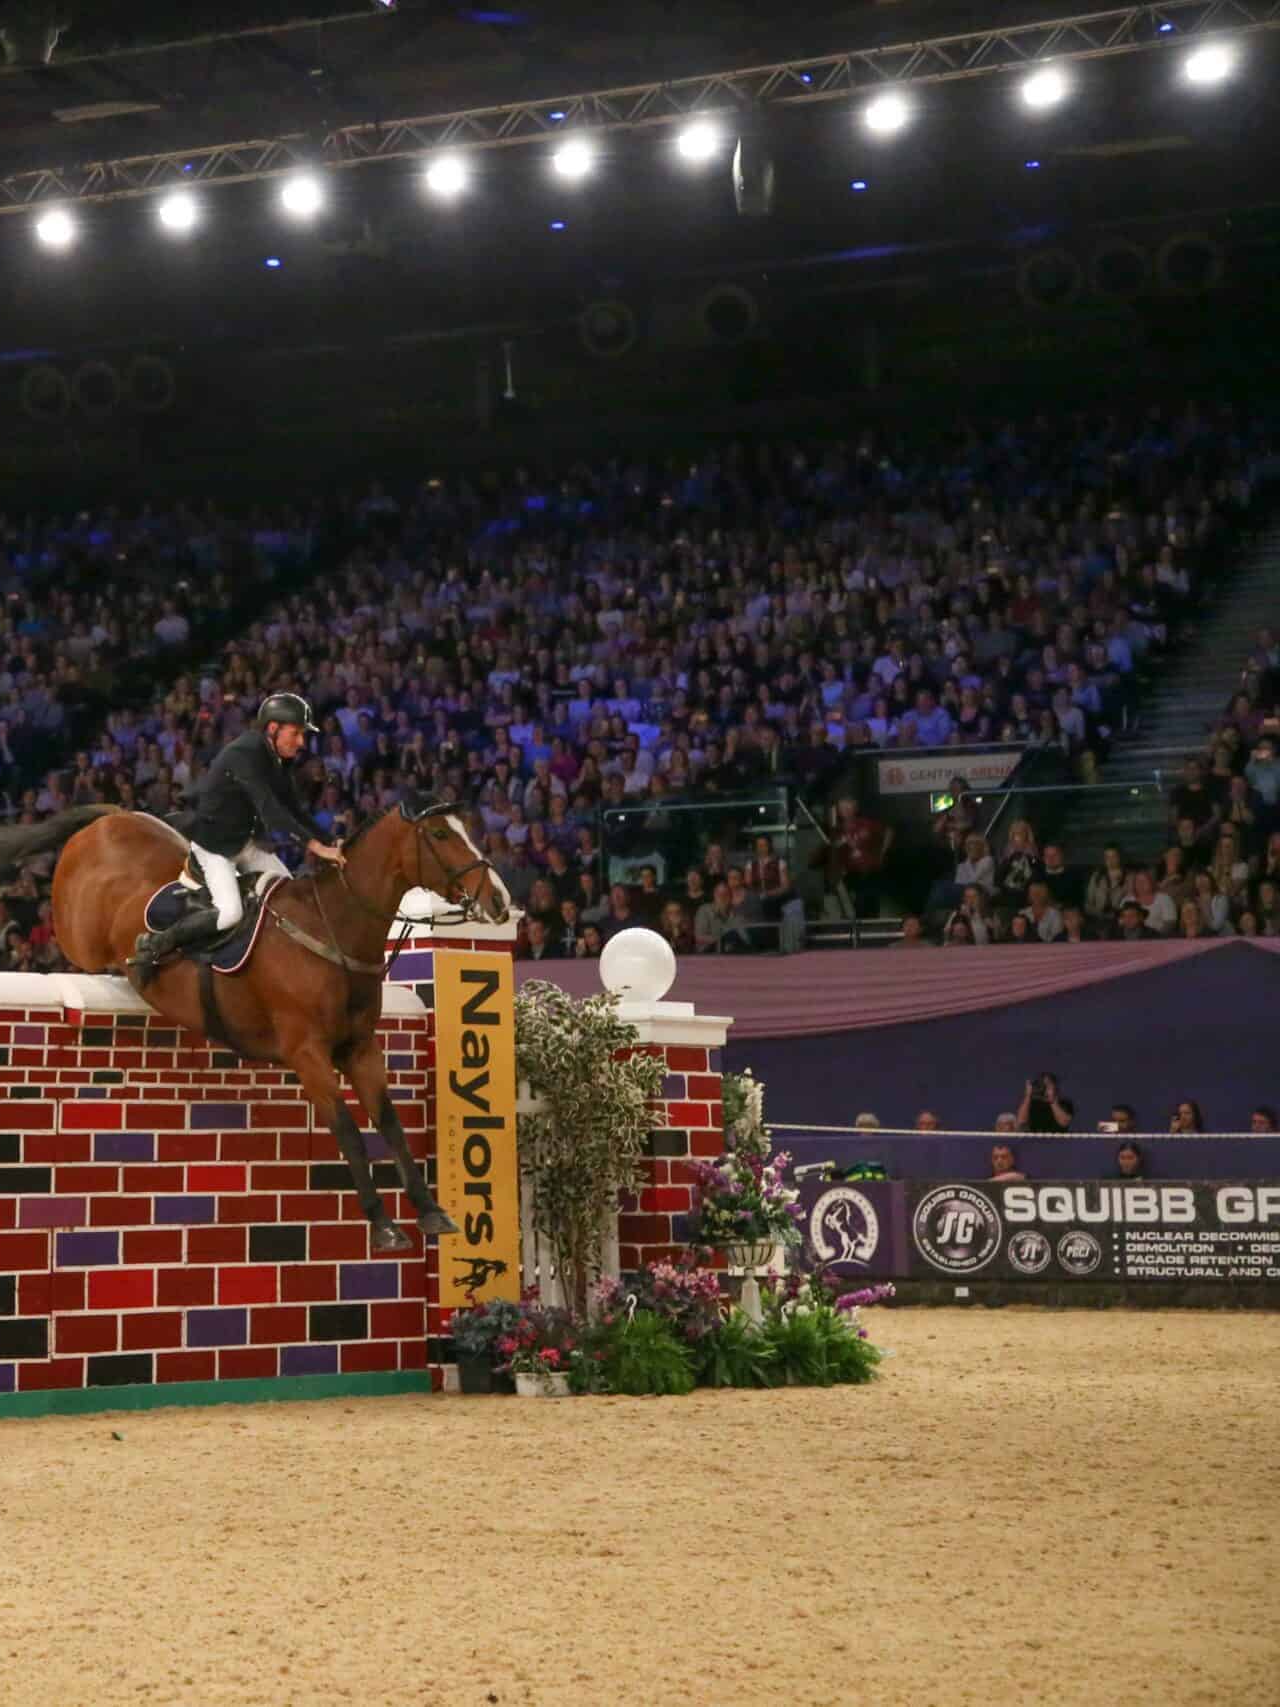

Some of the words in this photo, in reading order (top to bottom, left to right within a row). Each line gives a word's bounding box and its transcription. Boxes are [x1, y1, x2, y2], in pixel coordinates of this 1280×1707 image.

[448, 969, 505, 1246] Naylors
[1003, 1186, 1197, 1223] SQUIBB
[1125, 1231, 1194, 1242] NUCLEAR
[1125, 1243, 1215, 1254] DEMOLITION
[1125, 1255, 1185, 1266] FACADE
[1189, 1255, 1274, 1266] RETENTION
[1127, 1266, 1225, 1277] STRUCTURAL
[1228, 1266, 1262, 1278] AND
